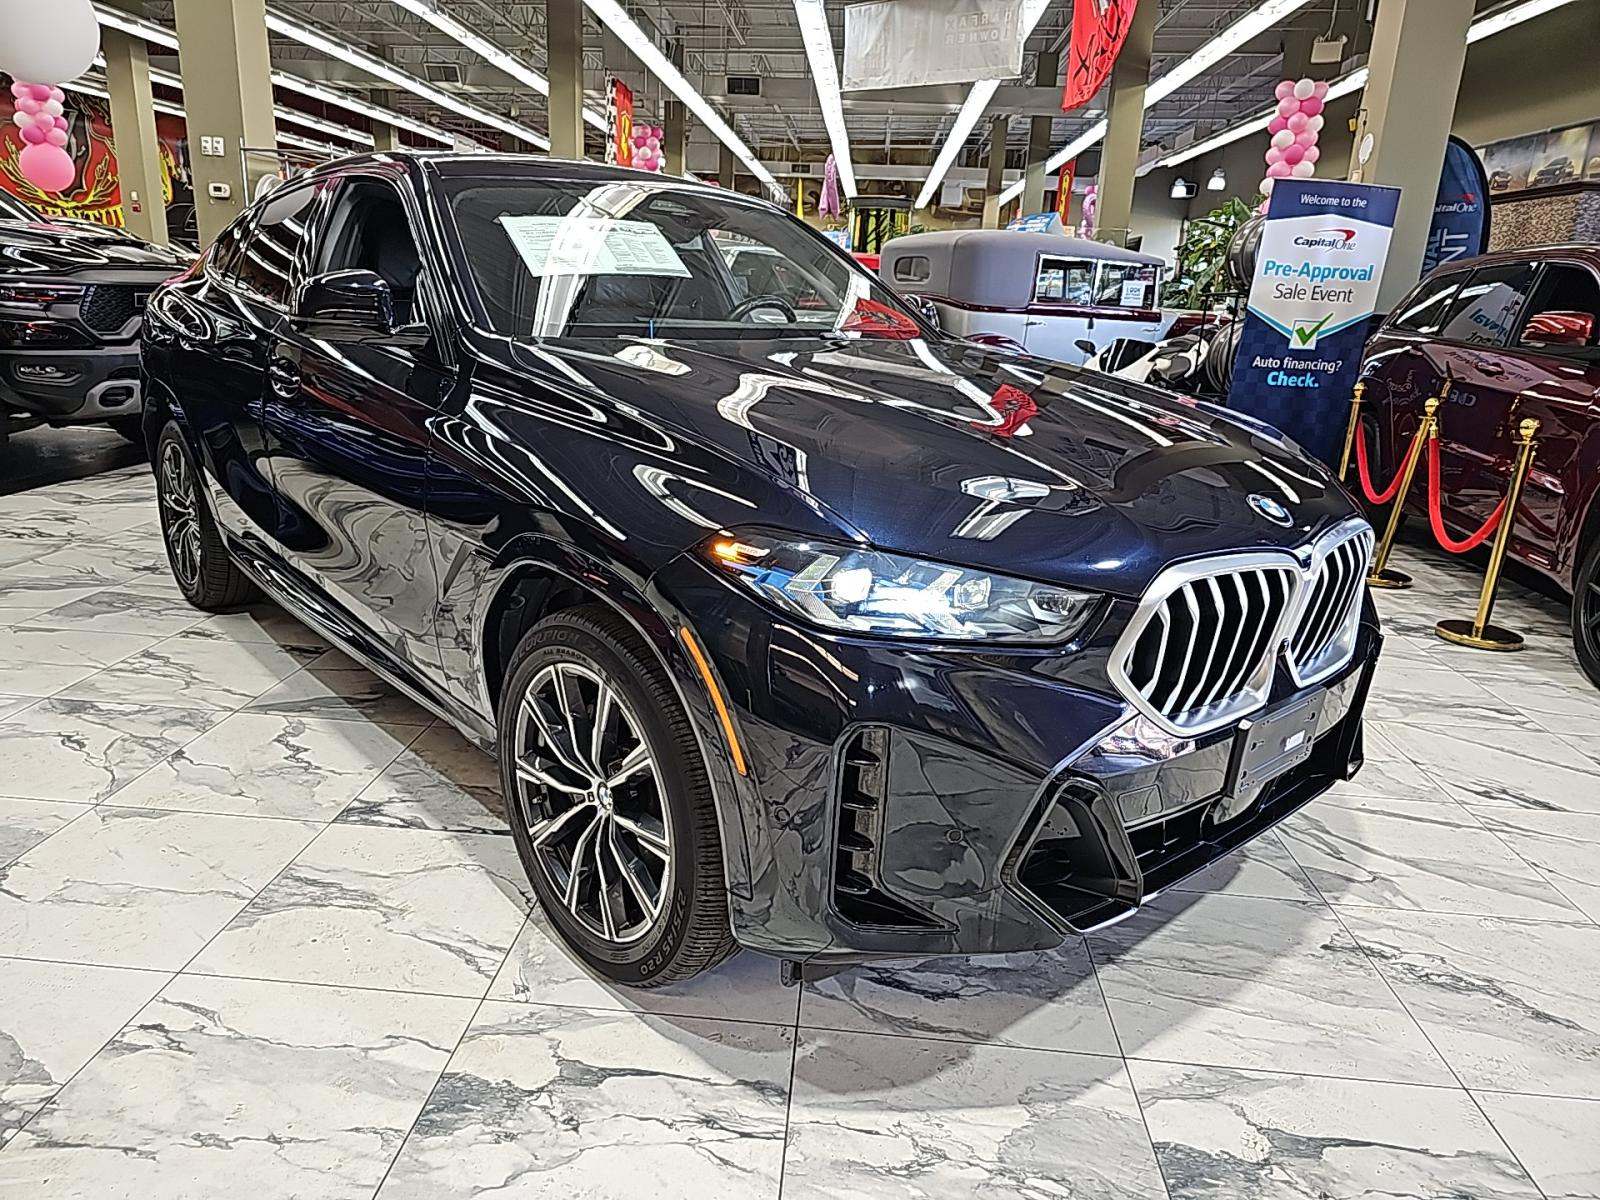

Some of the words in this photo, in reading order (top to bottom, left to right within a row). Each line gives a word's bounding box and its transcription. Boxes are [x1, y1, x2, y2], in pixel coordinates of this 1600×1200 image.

[1300, 194, 1340, 206] Welcome
[1341, 197, 1351, 207] to
[1352, 197, 1368, 208] the
[1263, 260, 1375, 282] Pre-Approval
[1273, 283, 1307, 300] Sale
[1310, 285, 1354, 303] Event
[1252, 355, 1281, 369] Auto
[1282, 356, 1342, 374] financing?
[1266, 371, 1320, 388] Check.
